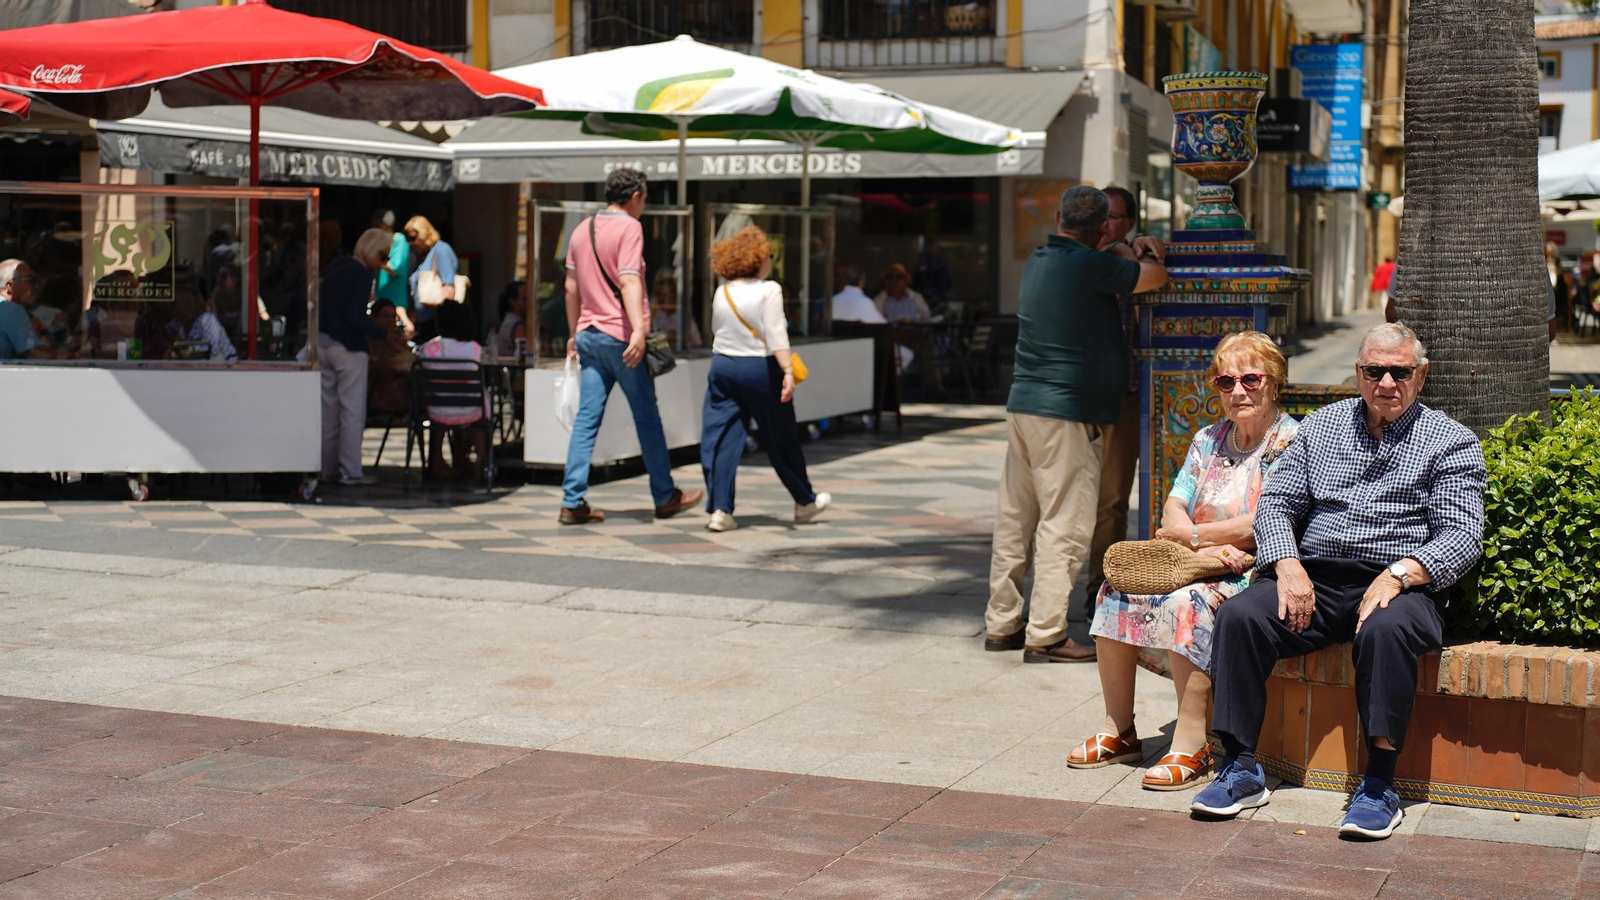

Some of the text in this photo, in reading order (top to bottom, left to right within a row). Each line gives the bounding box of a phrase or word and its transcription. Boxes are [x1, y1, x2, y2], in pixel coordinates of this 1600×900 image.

[190, 149, 224, 165] CAFÉ
[236, 154, 251, 168] BA
[268, 150, 391, 180] MERCEDES
[657, 161, 678, 173] BA
[702, 154, 862, 175] MERCEDES
